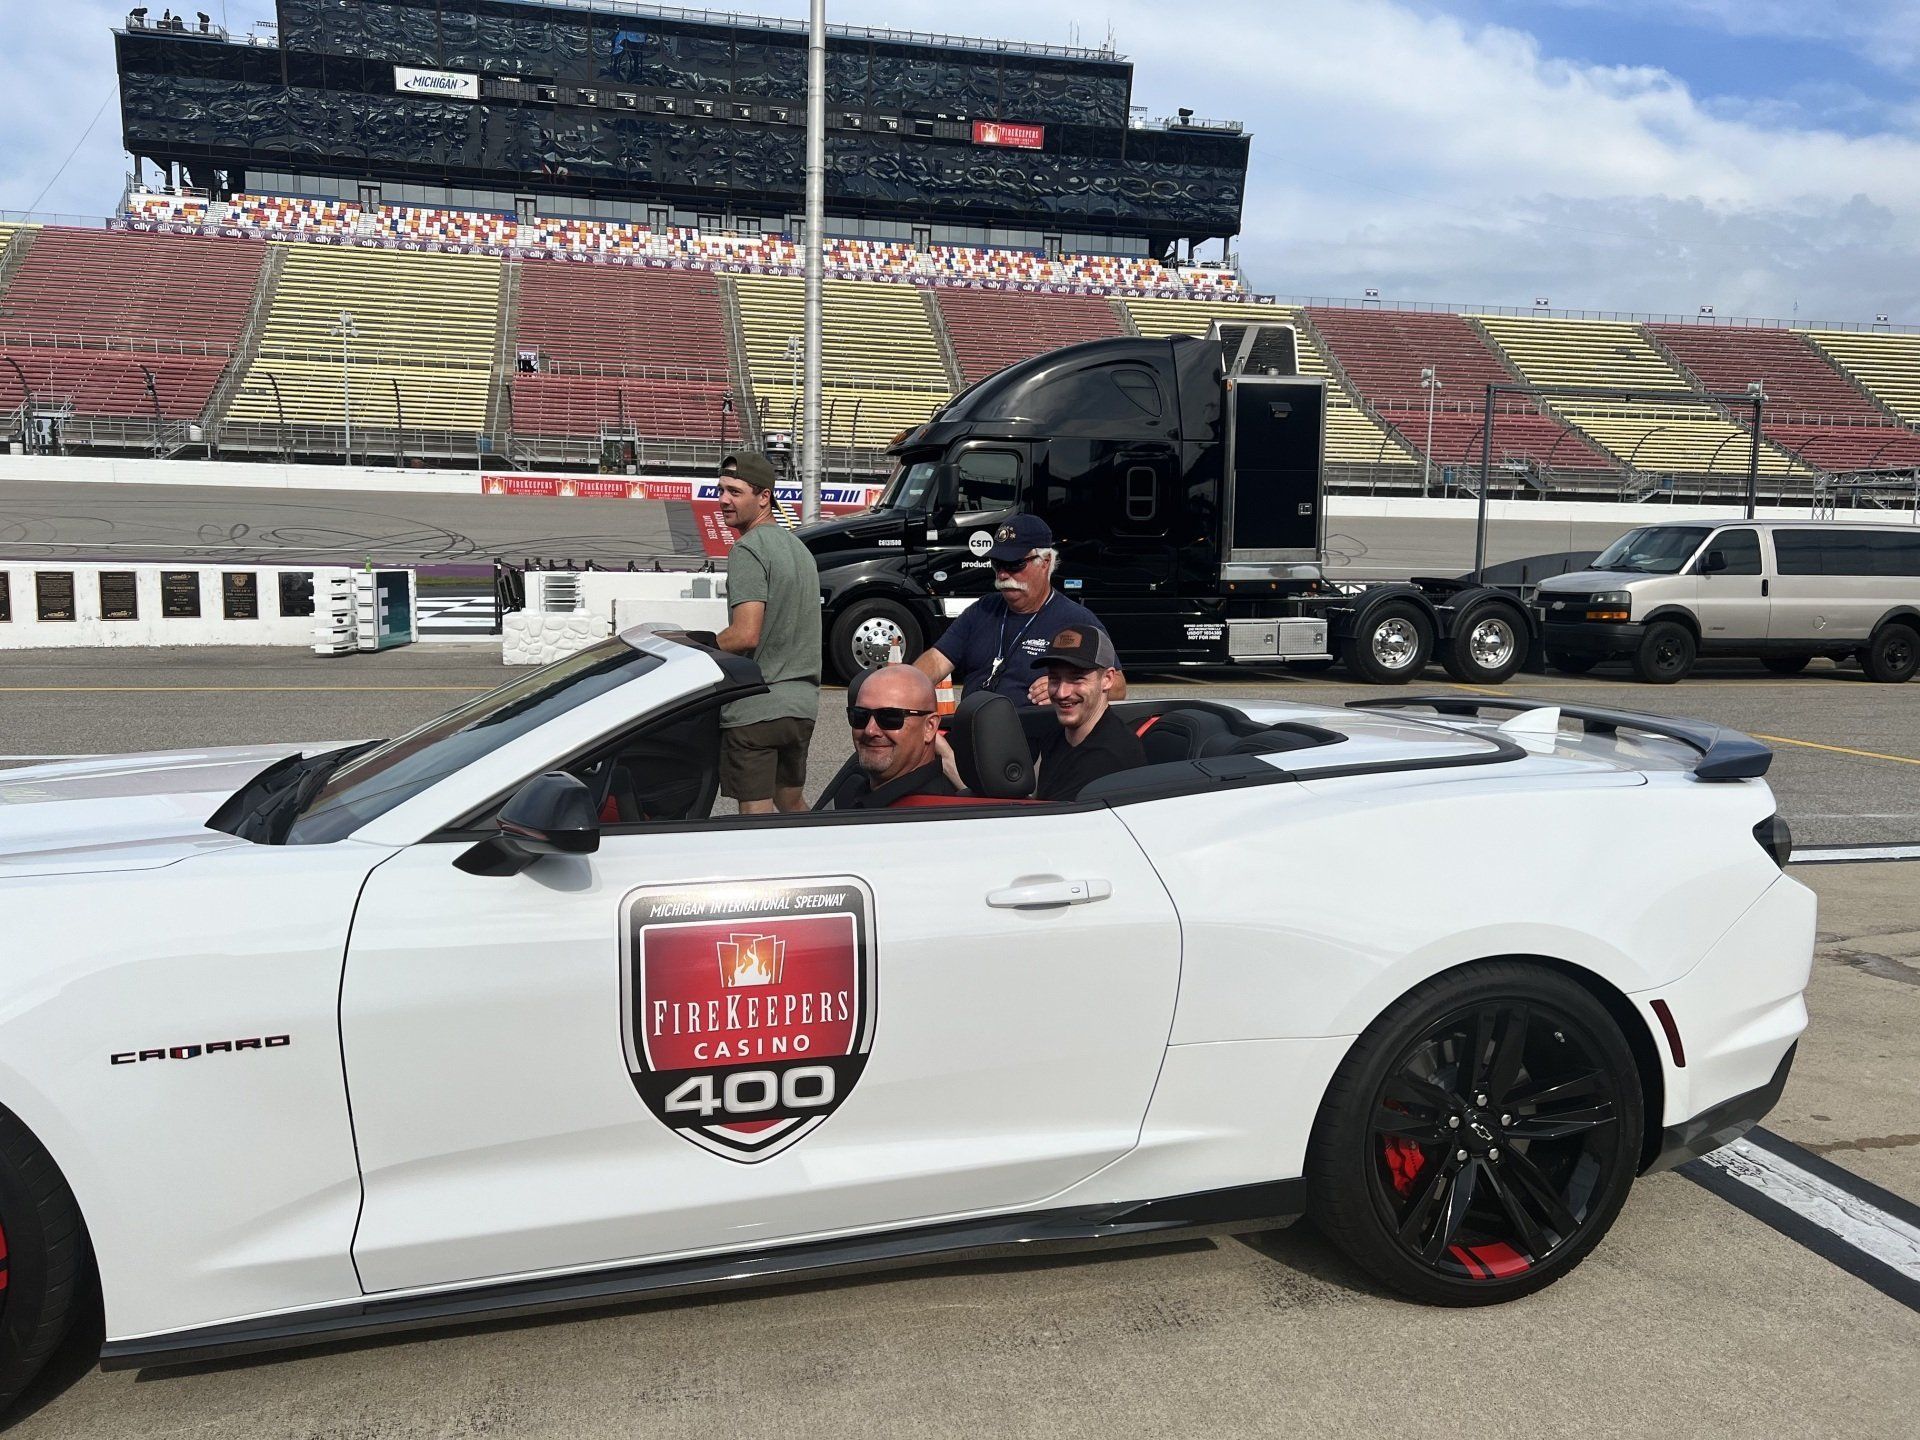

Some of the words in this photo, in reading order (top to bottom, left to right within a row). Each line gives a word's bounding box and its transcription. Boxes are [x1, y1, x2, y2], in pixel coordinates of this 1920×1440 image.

[412, 75, 458, 89] MICHIGAN
[134, 222, 151, 231] ally
[180, 226, 197, 235] ally
[226, 229, 242, 238] ally
[271, 232, 287, 241] ally
[315, 236, 331, 245] ally
[362, 239, 377, 248] ally
[405, 242, 420, 251] ally
[447, 245, 462, 254] ally
[489, 247, 504, 256] ally
[530, 250, 544, 259] ally
[572, 254, 587, 262] ally
[613, 257, 627, 265] ally
[652, 259, 666, 268] ally
[691, 262, 704, 270] ally
[729, 264, 743, 273] ally
[769, 267, 782, 275] ally
[843, 272, 856, 281] ally
[880, 274, 892, 283] ally
[915, 277, 928, 285] ally
[953, 279, 965, 287] ally
[988, 281, 1001, 289] ally
[1022, 284, 1035, 292] ally
[1057, 286, 1070, 294] ally
[1091, 287, 1104, 295] ally
[1127, 289, 1140, 297] ally
[1161, 291, 1173, 299] ally
[1194, 293, 1206, 301] ally
[1227, 295, 1240, 303] ally
[1260, 297, 1272, 305] ally
[508, 480, 553, 489] FIREKEEPERS
[580, 482, 623, 491] FIREKEEPERS
[649, 484, 691, 494] FIREKEEPERS
[970, 540, 992, 548] csm
[649, 902, 705, 918] MICHIGAN
[710, 895, 791, 915] INTERNATIONAL
[794, 892, 847, 909] SPEEDWAY
[653, 990, 849, 1036] FIREKEEPERS
[110, 1034, 290, 1065] CAARO
[694, 1034, 811, 1060] CASINO
[664, 1065, 836, 1117] 400
